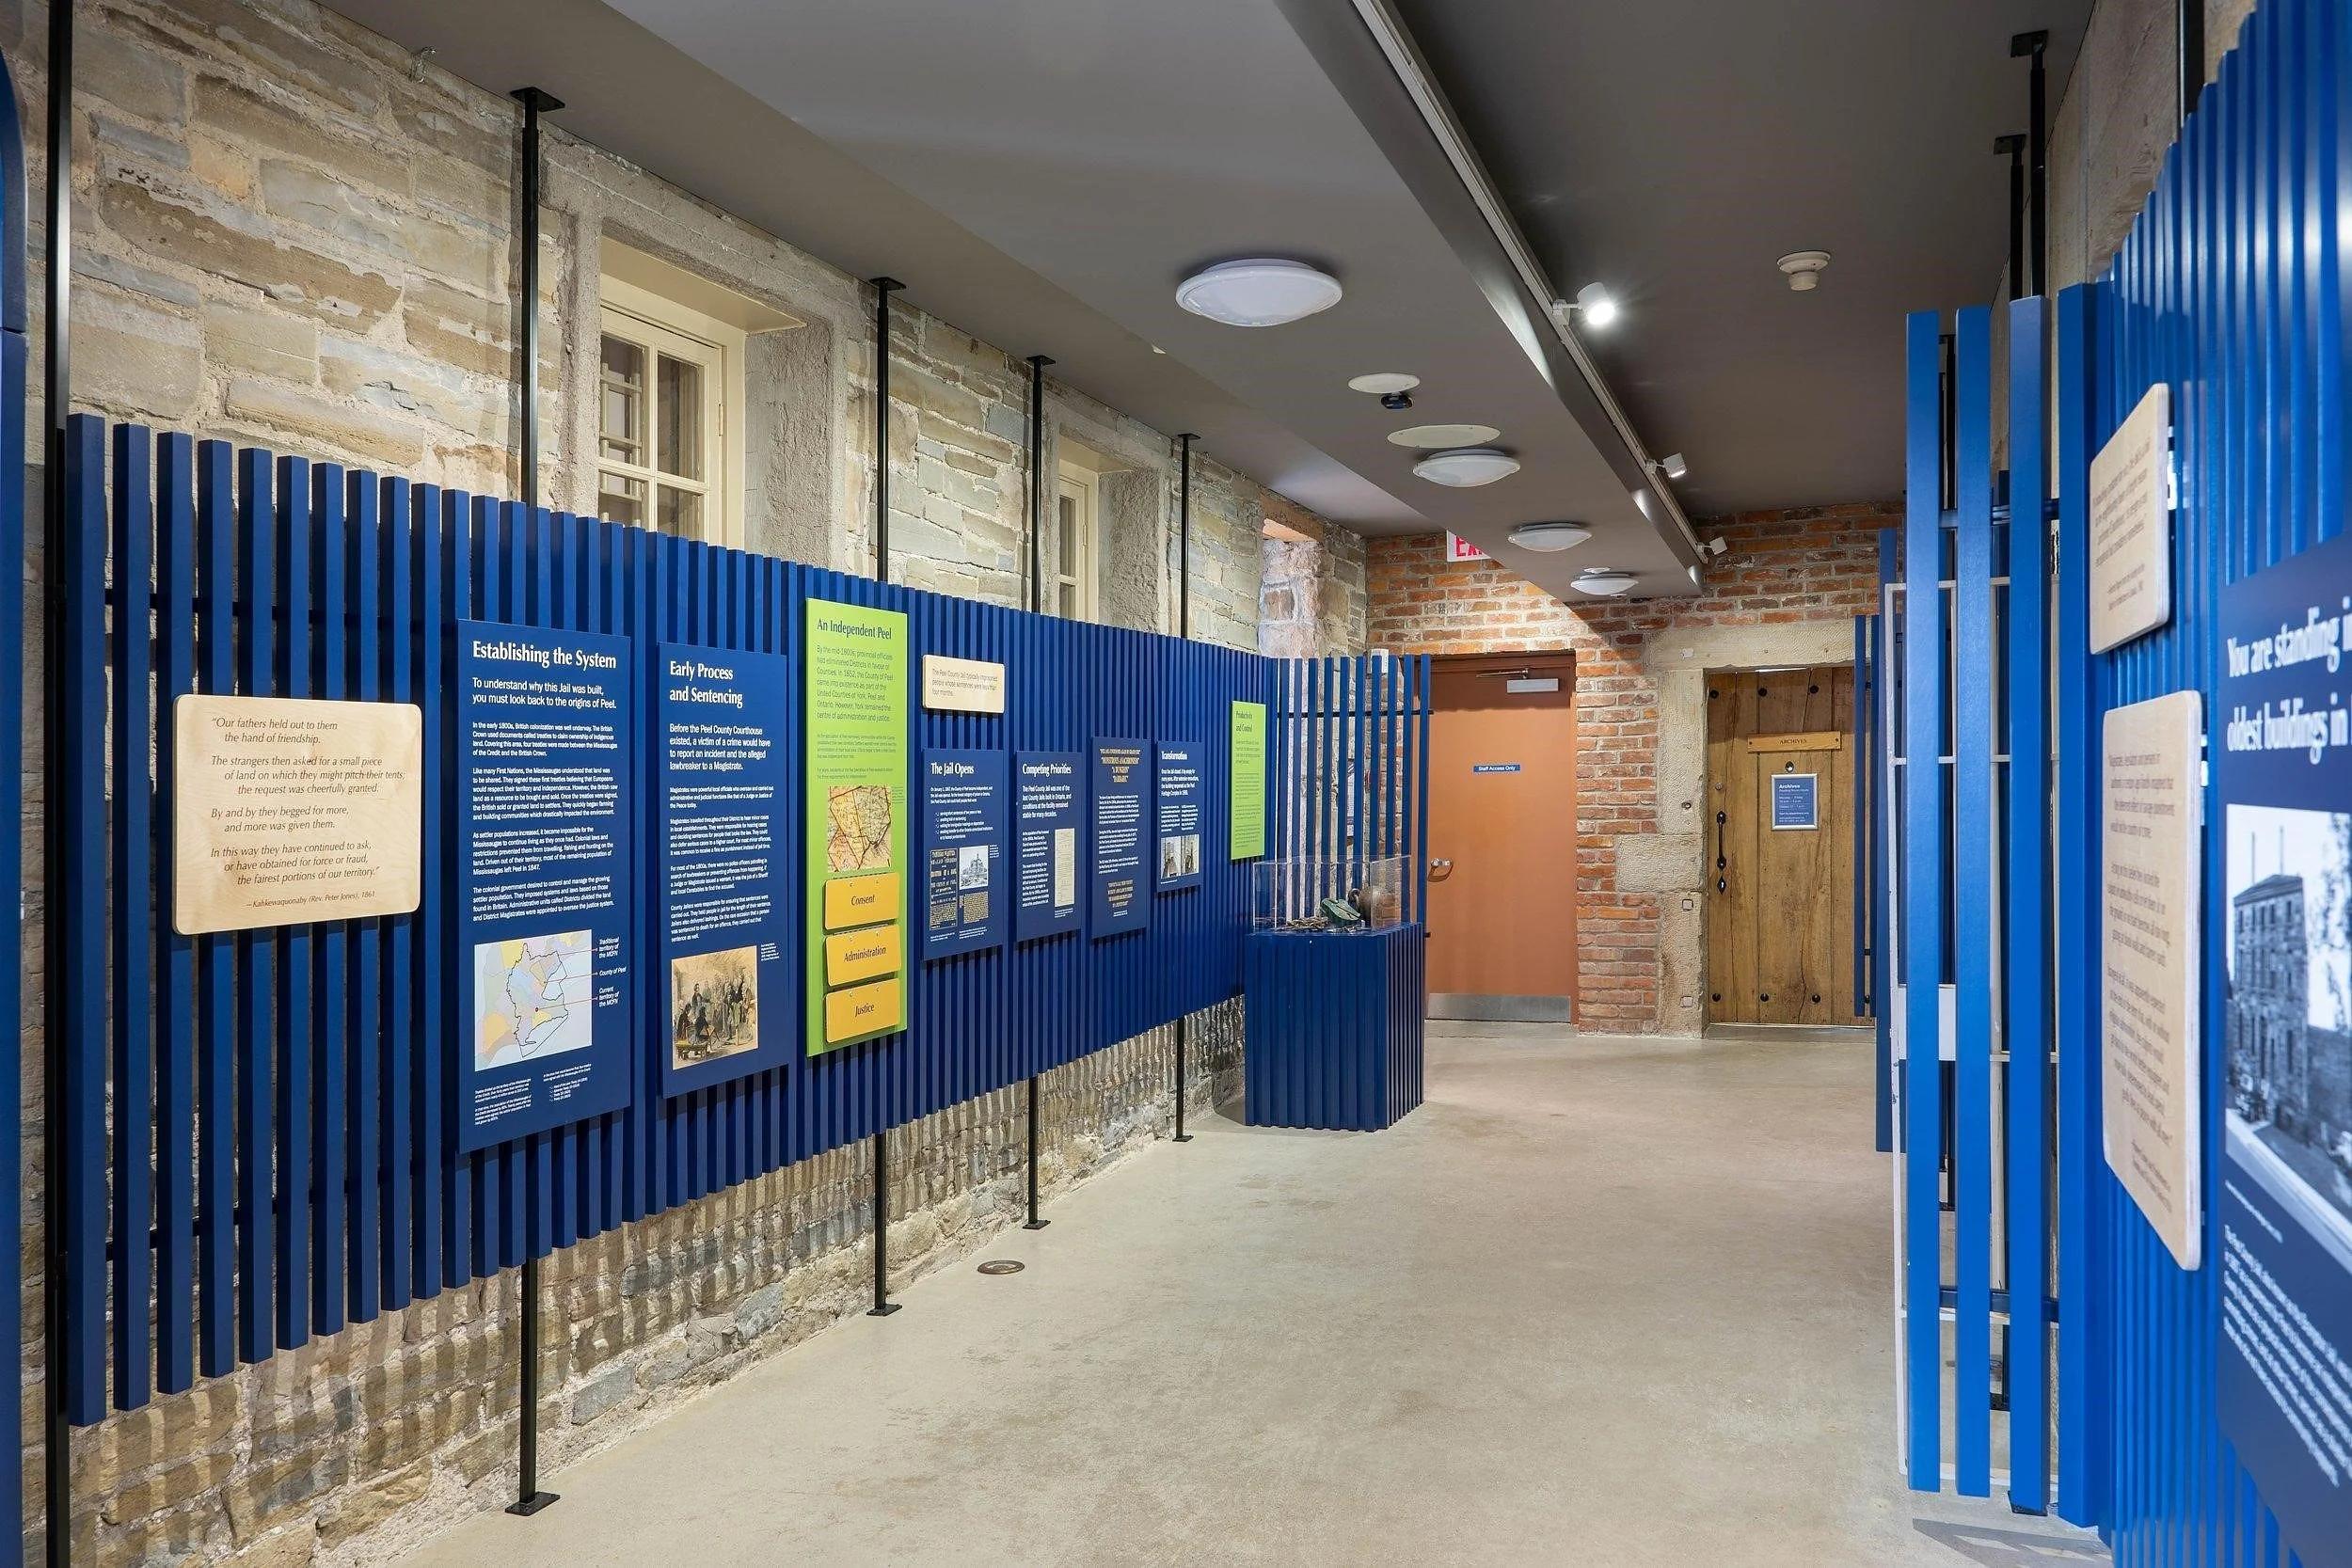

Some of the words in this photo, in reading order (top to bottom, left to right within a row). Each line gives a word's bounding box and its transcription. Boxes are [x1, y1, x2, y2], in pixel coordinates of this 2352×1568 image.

[817, 618, 828, 630] An
[830, 621, 876, 638] Independent
[877, 626, 891, 640] Peel
[2227, 637, 2249, 677] You
[2250, 638, 2272, 673] are
[2274, 606, 2340, 673] standing
[473, 641, 549, 668] Establishing
[553, 647, 573, 665] the
[576, 650, 616, 671] System
[670, 660, 695, 681] Early
[698, 663, 733, 680] Process
[472, 677, 483, 689] To
[484, 679, 527, 690] understand
[529, 682, 543, 693] why
[544, 682, 558, 692] this
[559, 683, 571, 693] Jail
[572, 686, 586, 694] was
[587, 685, 604, 696] built,
[472, 694, 486, 705] you
[489, 694, 508, 704] must
[510, 694, 526, 705] look
[528, 695, 546, 705] back
[546, 697, 554, 706] to
[555, 697, 567, 706] the
[568, 698, 591, 709] origins
[593, 698, 599, 708] of
[600, 699, 616, 709] Peel.
[670, 687, 689, 702] and
[691, 688, 743, 708] Sentencing
[236, 718, 266, 728] fathers
[269, 719, 288, 729] held
[306, 721, 314, 730] to
[317, 721, 338, 730] them
[670, 723, 689, 733] Before
[690, 724, 700, 734] the
[701, 724, 712, 734] Peel
[713, 725, 732, 736] County
[733, 726, 763, 736] Courthouse
[2227, 705, 2263, 751] oldest
[2264, 697, 2328, 765] buildings
[2330, 692, 2348, 746] in
[225, 731, 239, 742] the
[242, 732, 264, 743] hand
[266, 732, 276, 744] of
[277, 733, 320, 746] friendship.
[670, 736, 691, 746] existed,
[698, 737, 714, 746] victim
[715, 737, 722, 746] of
[723, 738, 726, 747] a
[727, 737, 742, 747] crime
[742, 738, 758, 747] would
[758, 738, 771, 747] have
[212, 755, 228, 766] The
[230, 757, 269, 768] strangers
[272, 755, 290, 766] then
[293, 755, 317, 766] asked
[318, 755, 331, 767] for
[340, 755, 359, 766] small
[360, 756, 382, 768] piece
[670, 750, 676, 758] to
[677, 750, 694, 759] report
[704, 750, 726, 758] incident
[726, 750, 738, 758] and
[738, 750, 747, 758] the
[748, 750, 766, 760] alleged
[670, 761, 701, 770] lawbreaker
[702, 762, 708, 770] to
[714, 762, 743, 771] Magistrate.
[931, 762, 943, 774] The
[944, 762, 953, 777] Jail
[955, 763, 975, 777] Opens
[1023, 764, 1050, 777] Competing
[1051, 764, 1072, 774] Priorities
[225, 769, 234, 780] of
[236, 769, 256, 780] land
[258, 771, 269, 780] on
[272, 769, 298, 780] which
[299, 769, 318, 782] they
[320, 769, 342, 782] might
[344, 769, 365, 782] pitch
[365, 769, 383, 779] their
[238, 784, 252, 794] the
[254, 785, 286, 797] request
[289, 785, 305, 794] was
[307, 783, 344, 796] cheerfully
[347, 783, 379, 795] granted.
[211, 808, 223, 819] By
[225, 807, 244, 817] and
[246, 807, 256, 819] by
[259, 806, 278, 818] they
[279, 805, 310, 818] begged
[312, 805, 325, 816] for
[326, 807, 349, 816] more,
[224, 822, 242, 832] and
[270, 822, 286, 831] was
[288, 820, 310, 832] given
[312, 818, 335, 829] them.
[210, 847, 220, 857] In
[222, 847, 238, 857] this
[241, 847, 259, 858] way
[262, 845, 279, 857] they
[281, 843, 302, 854] have
[304, 841, 345, 852] continued
[346, 842, 355, 850] to
[357, 840, 371, 850] ask,
[224, 863, 234, 872] or
[236, 860, 257, 870] have
[260, 858, 297, 869] obtained
[299, 857, 311, 868] for
[312, 856, 334, 866] force
[346, 853, 368, 864] fraud,
[237, 875, 251, 885] the
[254, 873, 279, 885] fairest
[281, 871, 316, 883] portions
[318, 868, 326, 880] of
[328, 870, 342, 879] our
[324, 894, 340, 902] Peter
[851, 895, 875, 906] Consent
[844, 946, 886, 962] Administration
[855, 1003, 874, 1017] Justice
